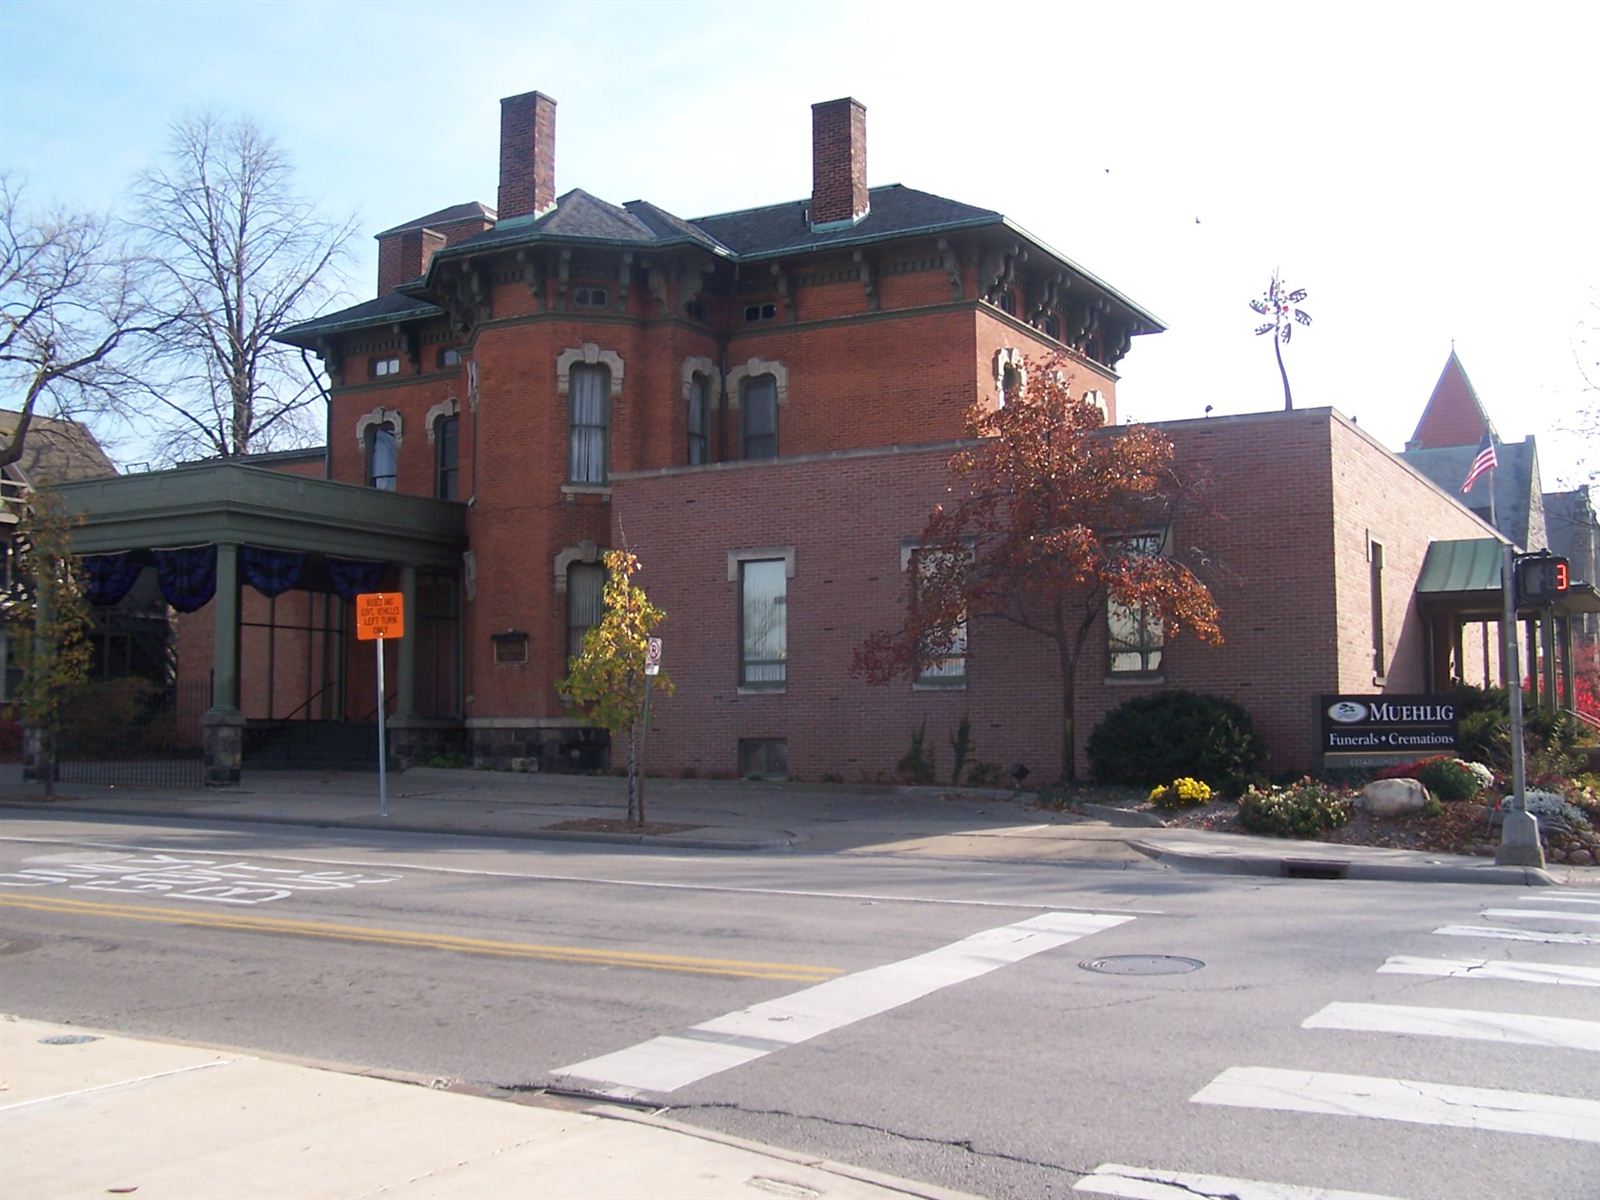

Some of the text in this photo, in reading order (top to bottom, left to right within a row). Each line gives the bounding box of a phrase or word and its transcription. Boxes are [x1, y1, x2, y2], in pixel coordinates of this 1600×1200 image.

[1556, 563, 1568, 591] 3
[364, 616, 398, 626] LEFT TURN
[1369, 703, 1454, 721] MUEHLIG
[1329, 732, 1454, 745] Funerals Cremations
[163, 871, 403, 904] BUS
